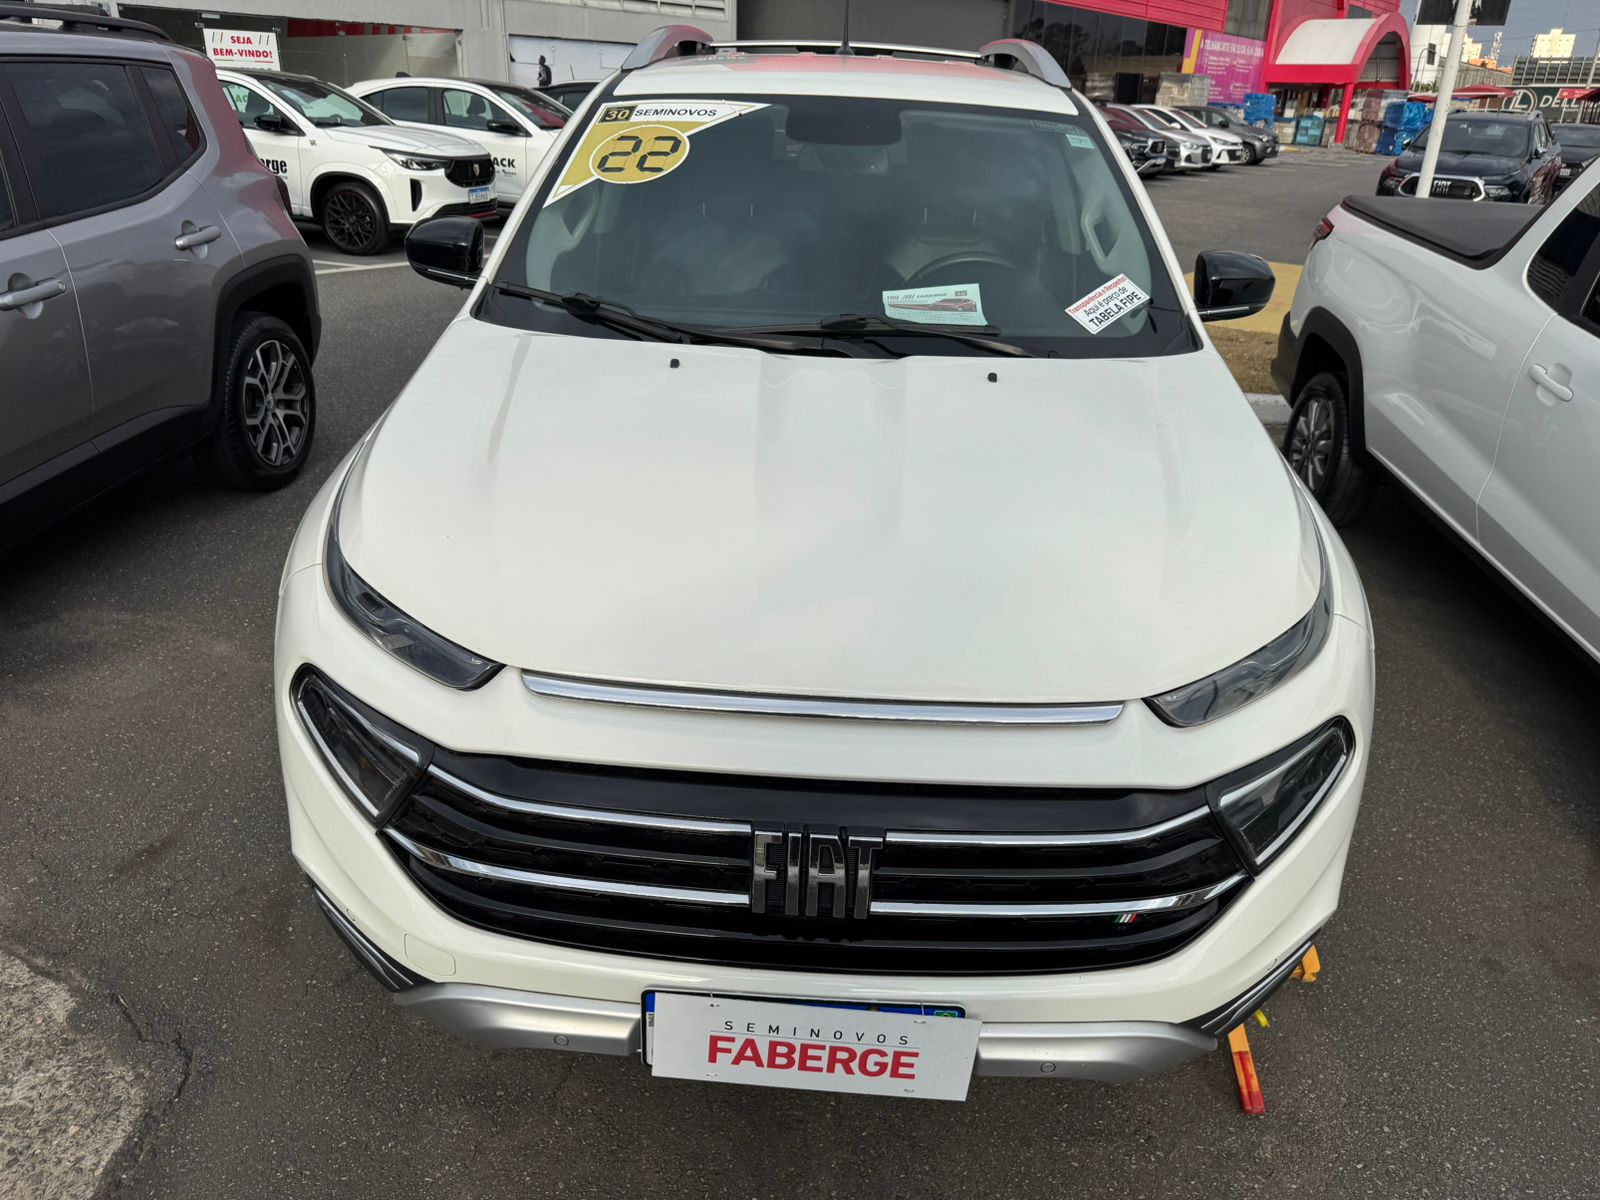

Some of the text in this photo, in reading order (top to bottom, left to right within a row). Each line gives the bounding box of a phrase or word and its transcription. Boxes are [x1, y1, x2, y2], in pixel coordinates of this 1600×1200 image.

[213, 47, 273, 59] BEM-VINDO!
[230, 35, 253, 45] SEJA
[604, 109, 629, 121] 30
[634, 108, 717, 117] SEMINOVOS
[597, 135, 682, 173] 22
[1084, 302, 1100, 317] Aqui
[1103, 290, 1121, 306] preço
[1118, 286, 1129, 295] de
[1089, 291, 1142, 327] TABELA FIPE
[752, 830, 884, 920] FIAT
[724, 1020, 909, 1046] SEMINOVOS
[707, 1034, 920, 1080] FABERGE
